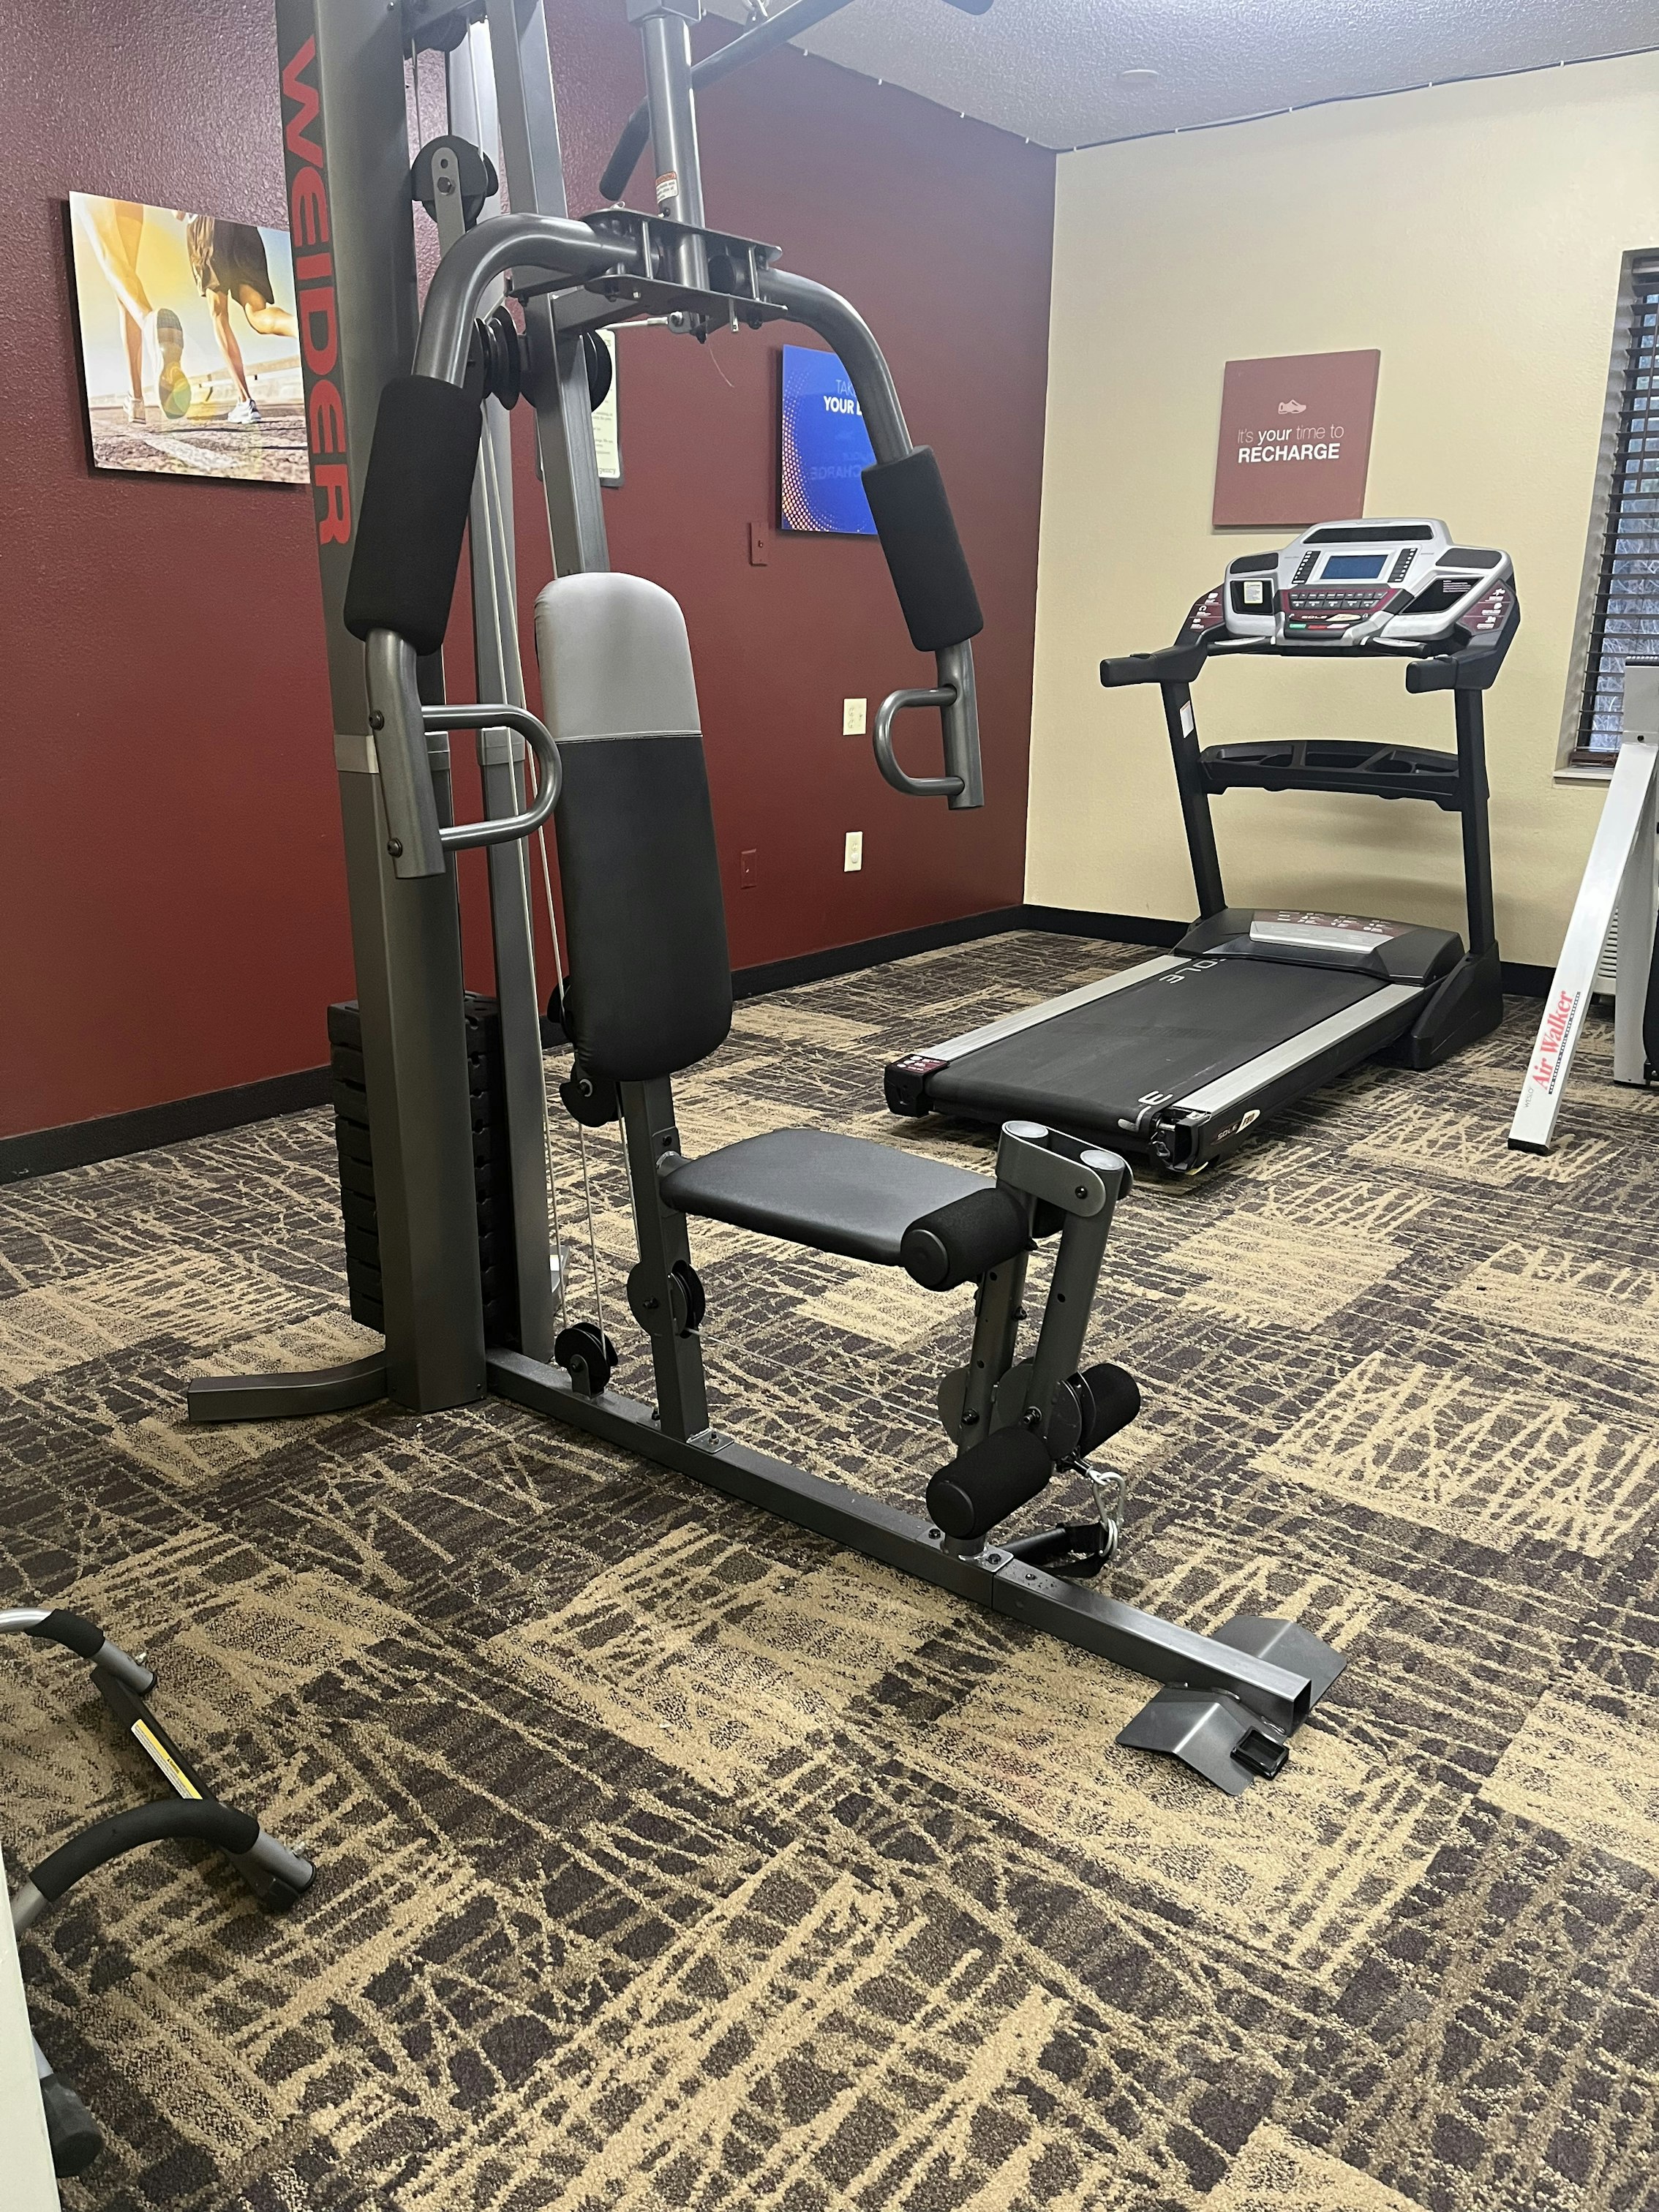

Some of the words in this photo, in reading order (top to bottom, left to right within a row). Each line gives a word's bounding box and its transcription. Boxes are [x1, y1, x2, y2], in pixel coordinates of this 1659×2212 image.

[282, 35, 352, 546] WEIDER
[835, 379, 857, 396] TAK
[823, 396, 854, 415] YOUR
[1237, 429, 1254, 444] It's
[1257, 429, 1293, 445] your
[1296, 424, 1325, 440] time
[1330, 424, 1344, 439] to
[1238, 443, 1341, 463] RECHARGE
[1159, 958, 1227, 984] OLE
[1540, 990, 1573, 1055] Walker
[1532, 1058, 1553, 1091] Air
[1217, 1124, 1238, 1140] SOLE
